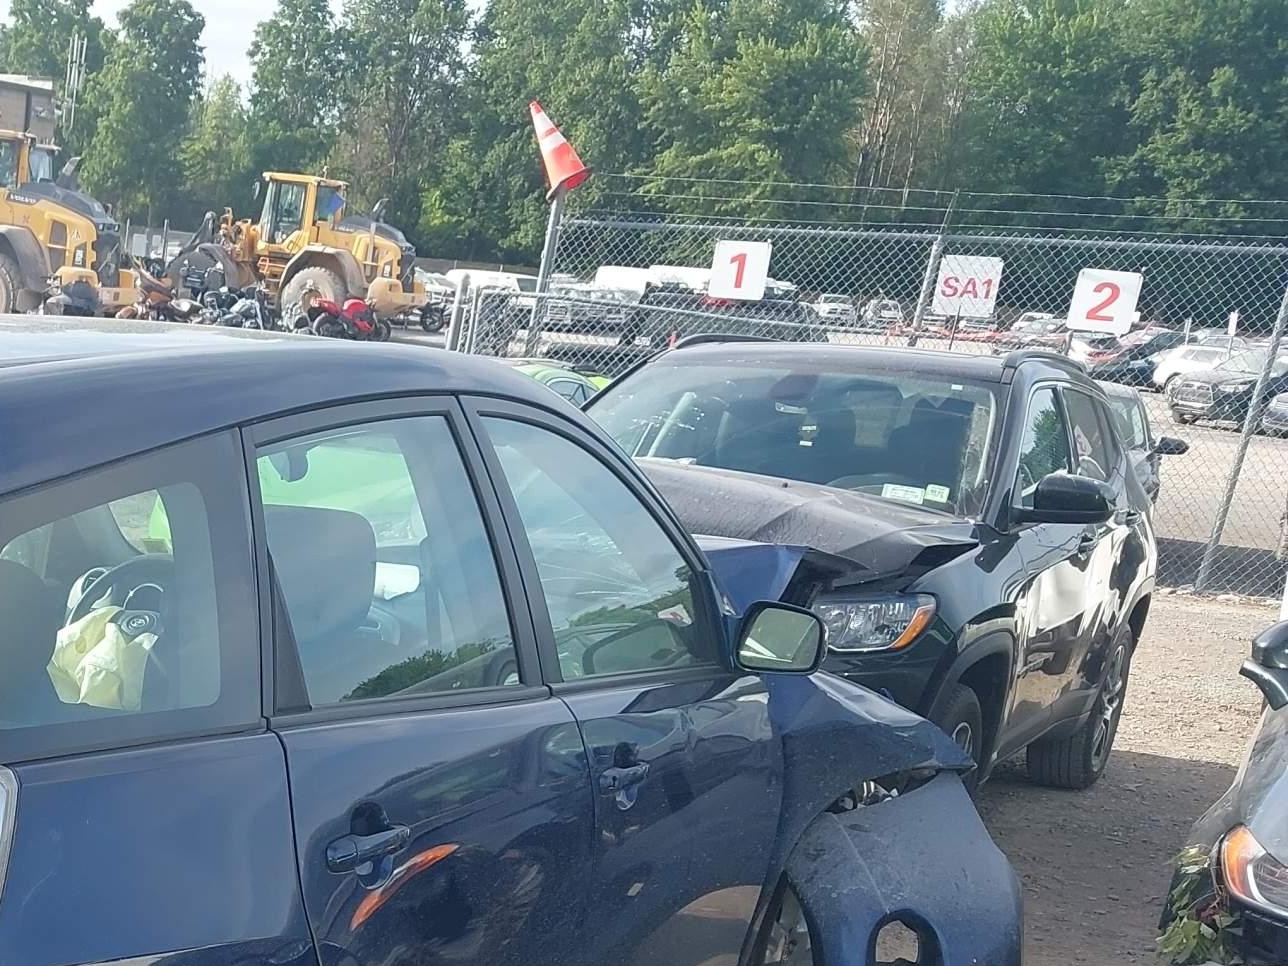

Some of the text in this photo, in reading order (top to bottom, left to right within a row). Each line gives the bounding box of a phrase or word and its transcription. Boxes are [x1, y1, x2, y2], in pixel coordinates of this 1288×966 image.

[729, 253, 748, 289] 1
[940, 276, 994, 300] SA1
[1085, 282, 1121, 322] 2
